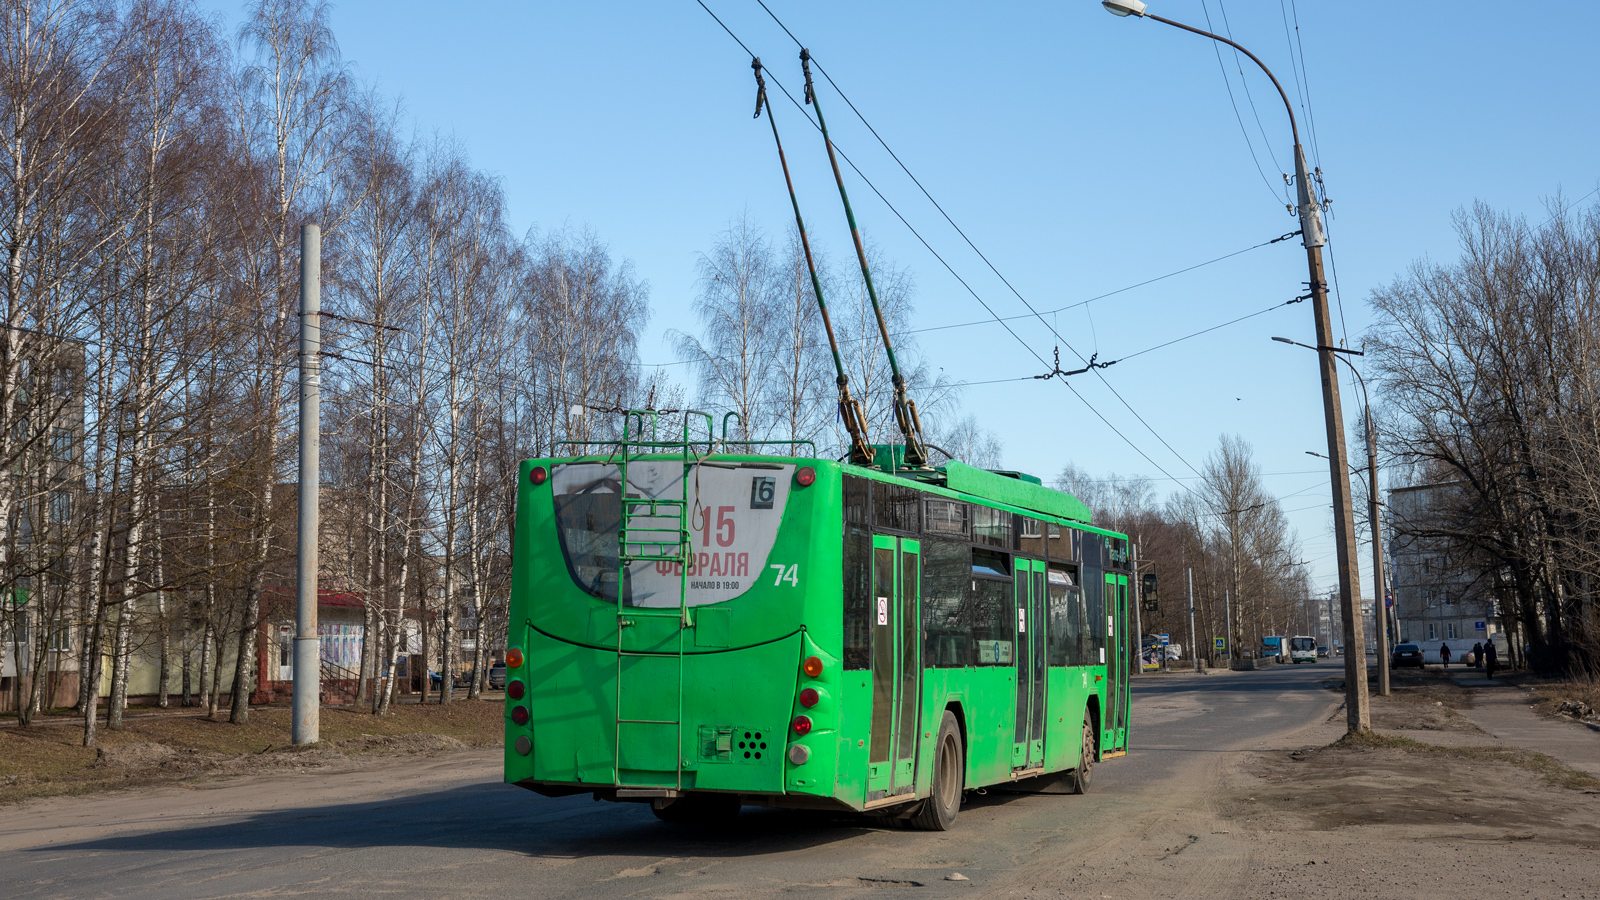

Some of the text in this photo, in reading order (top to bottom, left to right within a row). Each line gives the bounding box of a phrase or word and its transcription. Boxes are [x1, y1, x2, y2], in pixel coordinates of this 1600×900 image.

[758, 480, 774, 502] 6
[699, 506, 735, 547] 15
[655, 552, 749, 577] ФЕВРАЛЯ
[770, 564, 799, 587] 74
[690, 581, 740, 590] НАЧАЛО В 19:00
